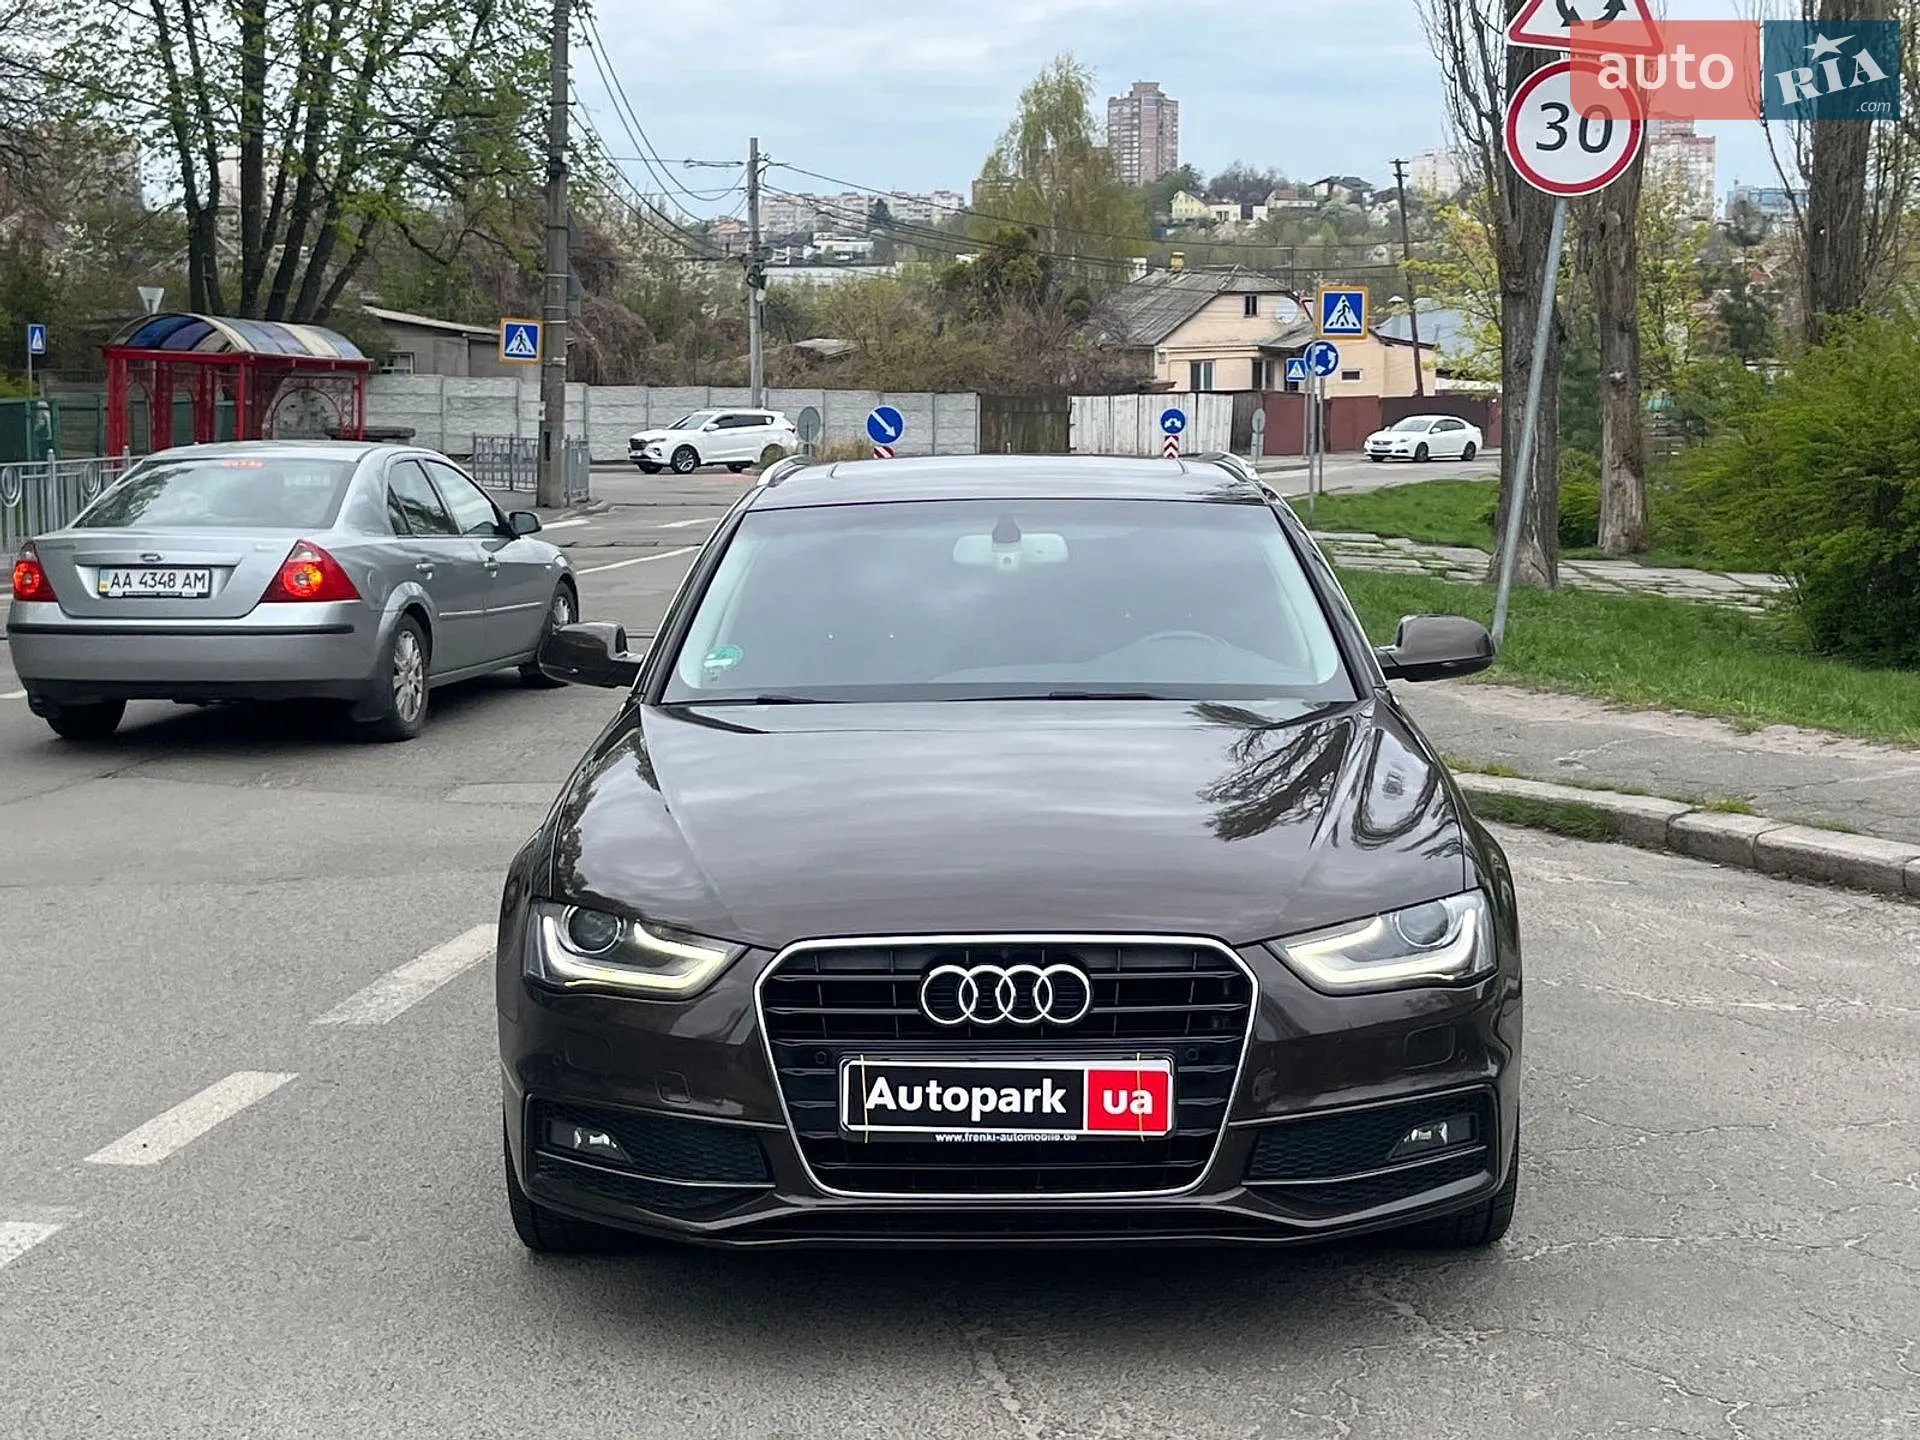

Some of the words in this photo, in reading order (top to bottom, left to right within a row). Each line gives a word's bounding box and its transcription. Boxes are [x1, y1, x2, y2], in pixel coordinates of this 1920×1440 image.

[1536, 102, 1613, 153] 30
[110, 572, 132, 589] AA
[139, 572, 177, 589] 4348
[181, 572, 206, 589] AM
[866, 1076, 1067, 1121] Autopark
[1103, 1089, 1153, 1115] ua
